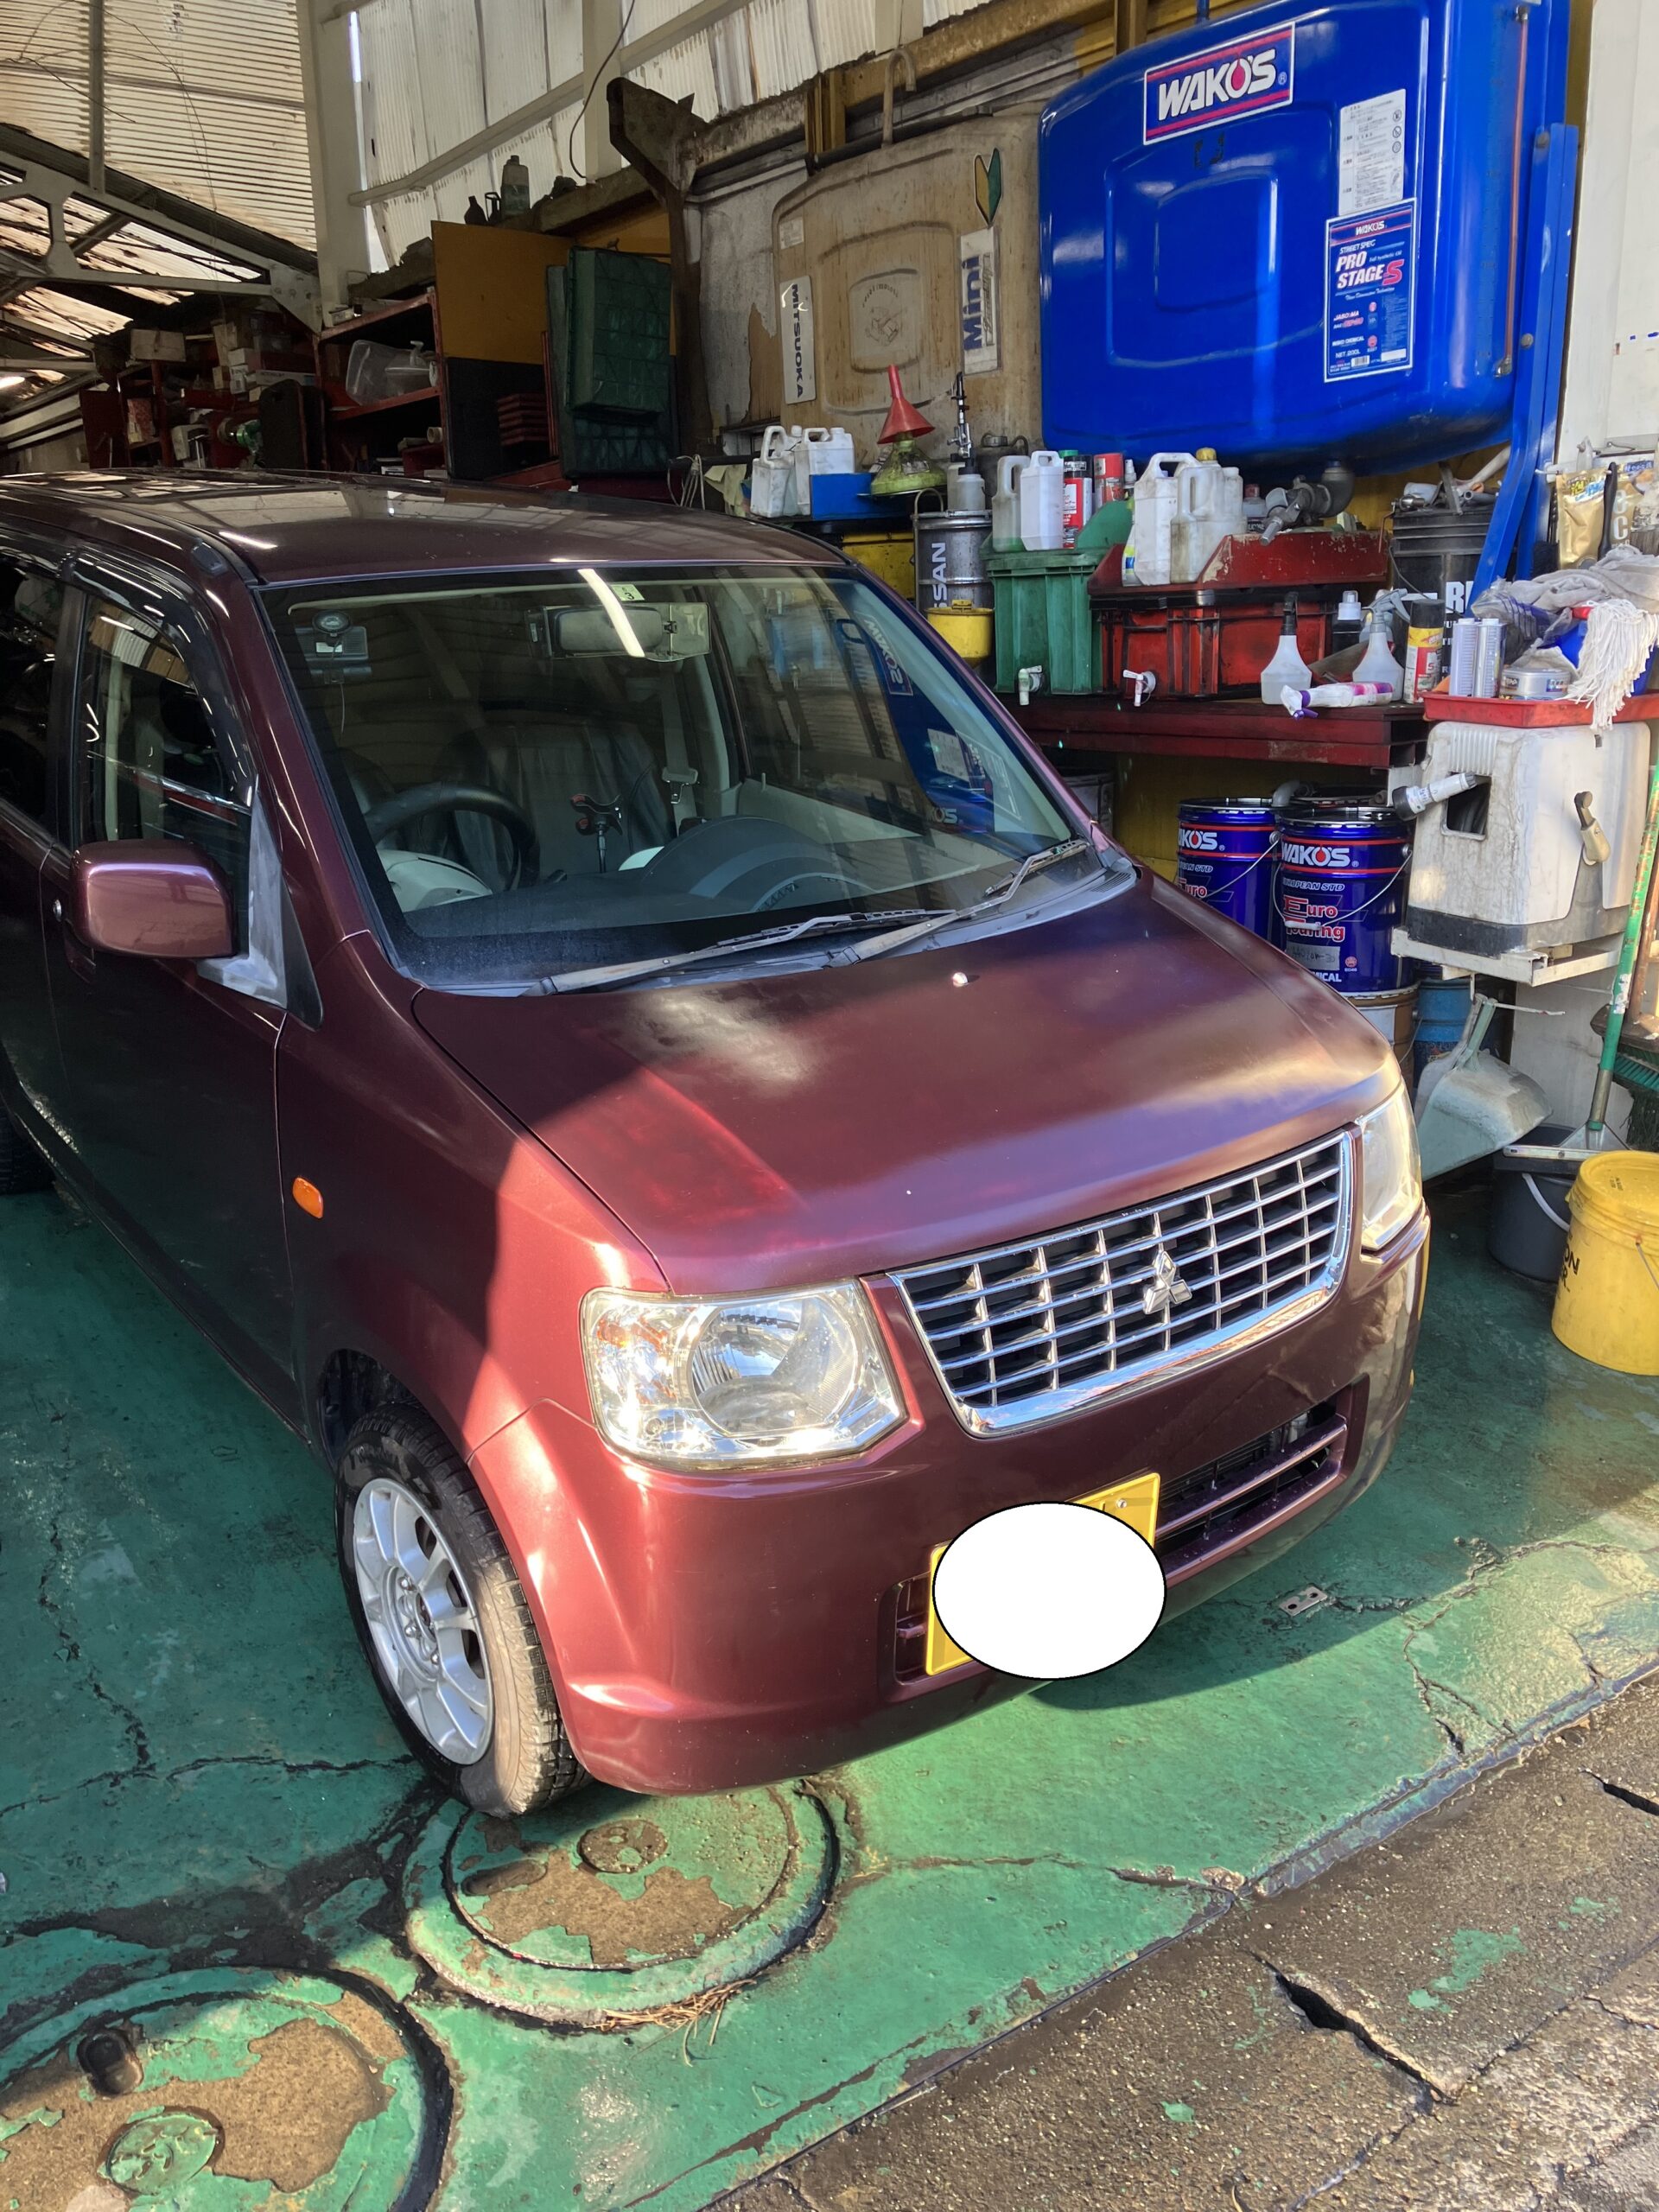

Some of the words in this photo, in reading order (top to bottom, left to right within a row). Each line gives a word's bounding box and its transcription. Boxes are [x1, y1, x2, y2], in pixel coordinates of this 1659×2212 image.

[1158, 48, 1276, 121] WAKO'S
[1336, 251, 1367, 272] PRO
[962, 255, 983, 351] Mini
[791, 283, 804, 398] MITSUOKA
[931, 542, 948, 608] SAN
[1178, 829, 1218, 851] KO'S
[1283, 894, 1338, 918] Euro
[1320, 883, 1345, 892] STD
